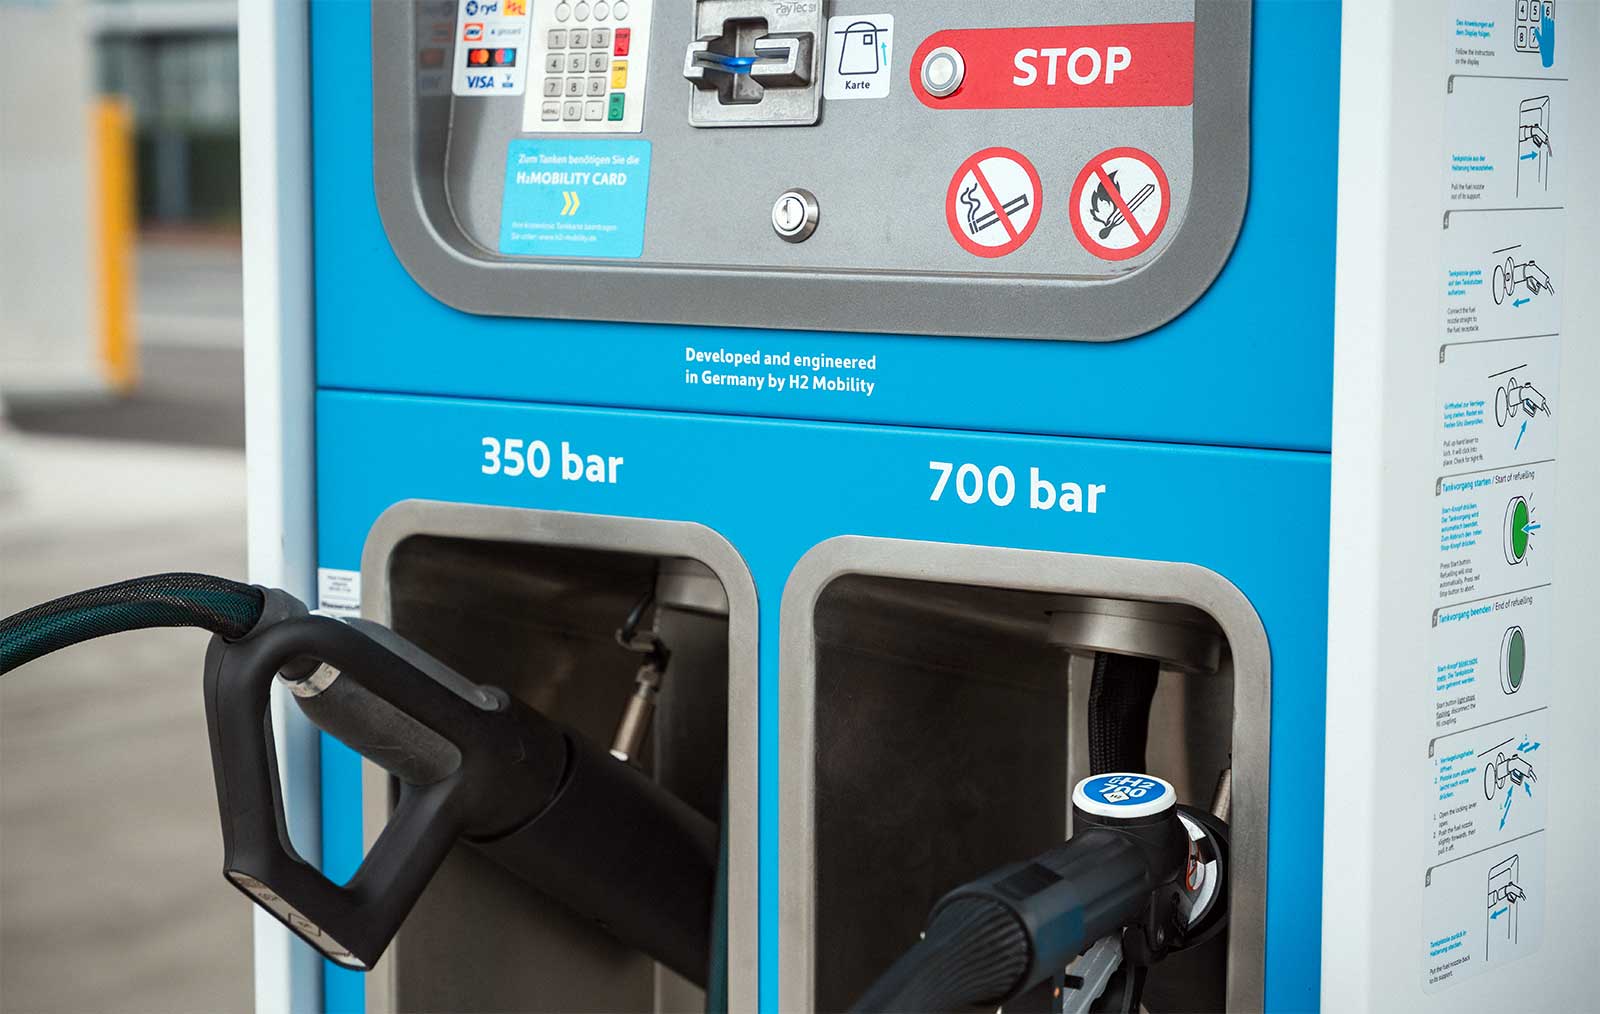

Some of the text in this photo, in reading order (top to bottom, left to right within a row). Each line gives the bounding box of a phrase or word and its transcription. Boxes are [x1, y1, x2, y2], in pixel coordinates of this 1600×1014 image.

[480, 1, 497, 16] ryd
[1533, 6, 1538, 15] 5
[1546, 6, 1550, 16] 6
[554, 35, 559, 44] 1
[576, 34, 581, 44] 2
[597, 34, 603, 44] 3
[551, 59, 557, 68] 4
[573, 58, 579, 68] 5
[595, 57, 600, 67] 6
[1012, 46, 1132, 86] STOP
[467, 76, 494, 88] VISA
[550, 83, 556, 92] 7
[571, 83, 576, 92] 8
[592, 82, 598, 91] 9
[844, 79, 870, 90] Karte
[519, 154, 640, 166] Zum Tanken benötigen Sie die
[592, 173, 627, 186] CARD
[686, 347, 876, 371] Developed and engineered
[686, 370, 875, 396] in Germany by H2 Mobility
[481, 437, 624, 484] 350 bar
[1474, 478, 1492, 487] starten
[1496, 475, 1506, 484] Start
[1507, 474, 1512, 482] of
[1513, 471, 1534, 480] refuelling
[928, 461, 1106, 514] 700 bar
[1471, 605, 1492, 616] beenden
[1496, 602, 1504, 610] End
[1505, 600, 1510, 608] of
[1511, 596, 1533, 606] refuelling
